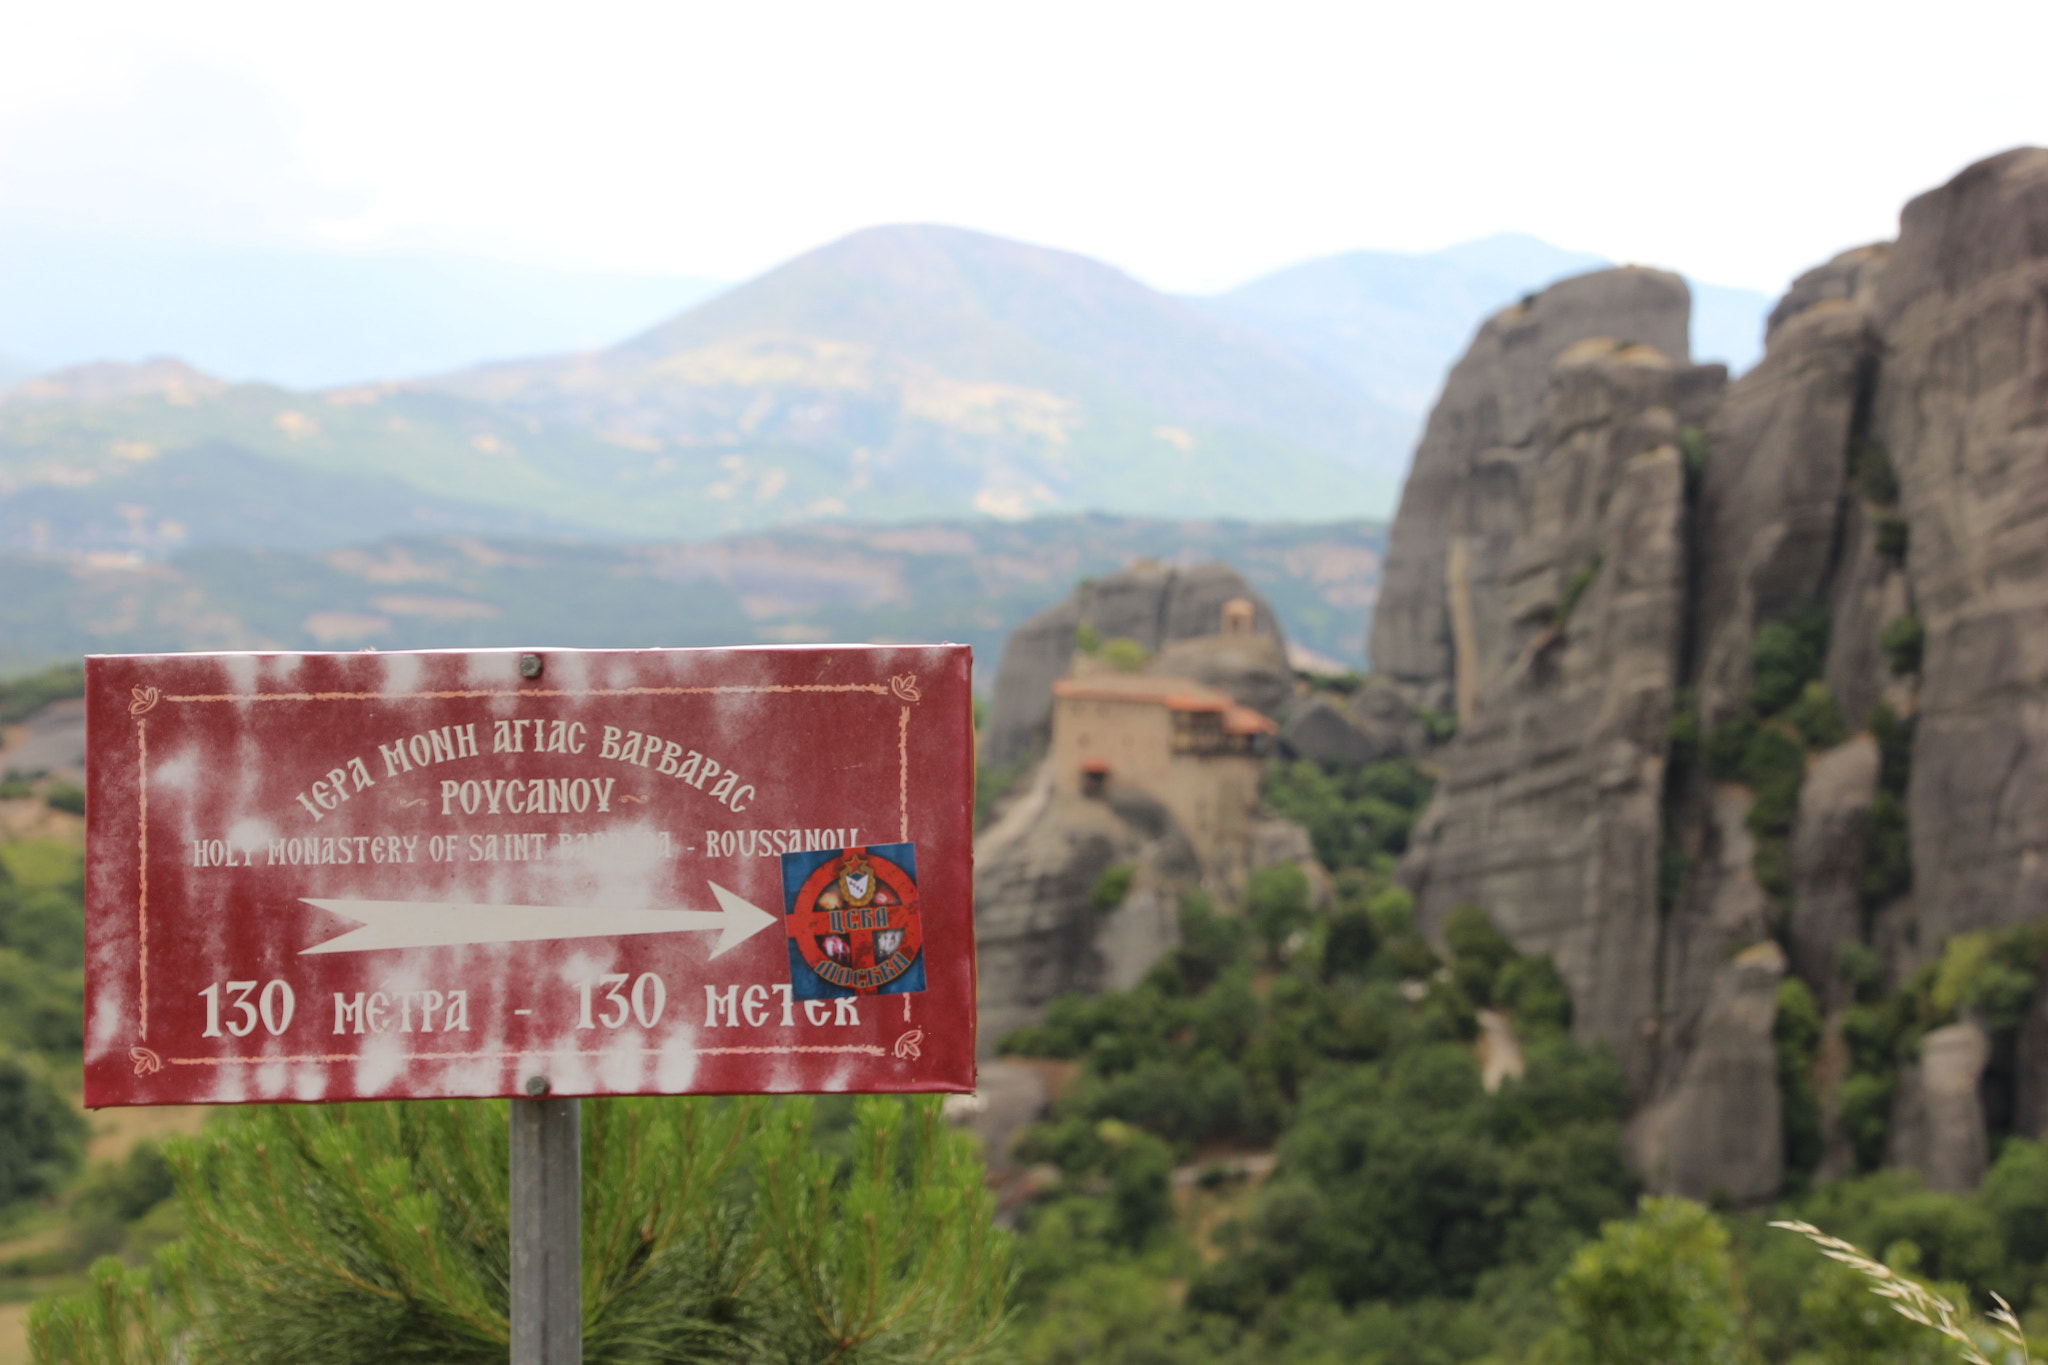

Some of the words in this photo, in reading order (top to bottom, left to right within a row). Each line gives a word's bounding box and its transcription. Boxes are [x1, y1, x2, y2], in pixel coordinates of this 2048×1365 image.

[296, 756, 376, 822] ΙΕΡΑ
[378, 723, 479, 778] ΜΟΝΗ
[193, 839, 253, 867] HOLY
[267, 835, 418, 865] MONASTERY
[429, 835, 458, 862] OF
[469, 833, 547, 861] SAINT
[197, 979, 295, 1037] 130
[574, 972, 667, 1029] 130
